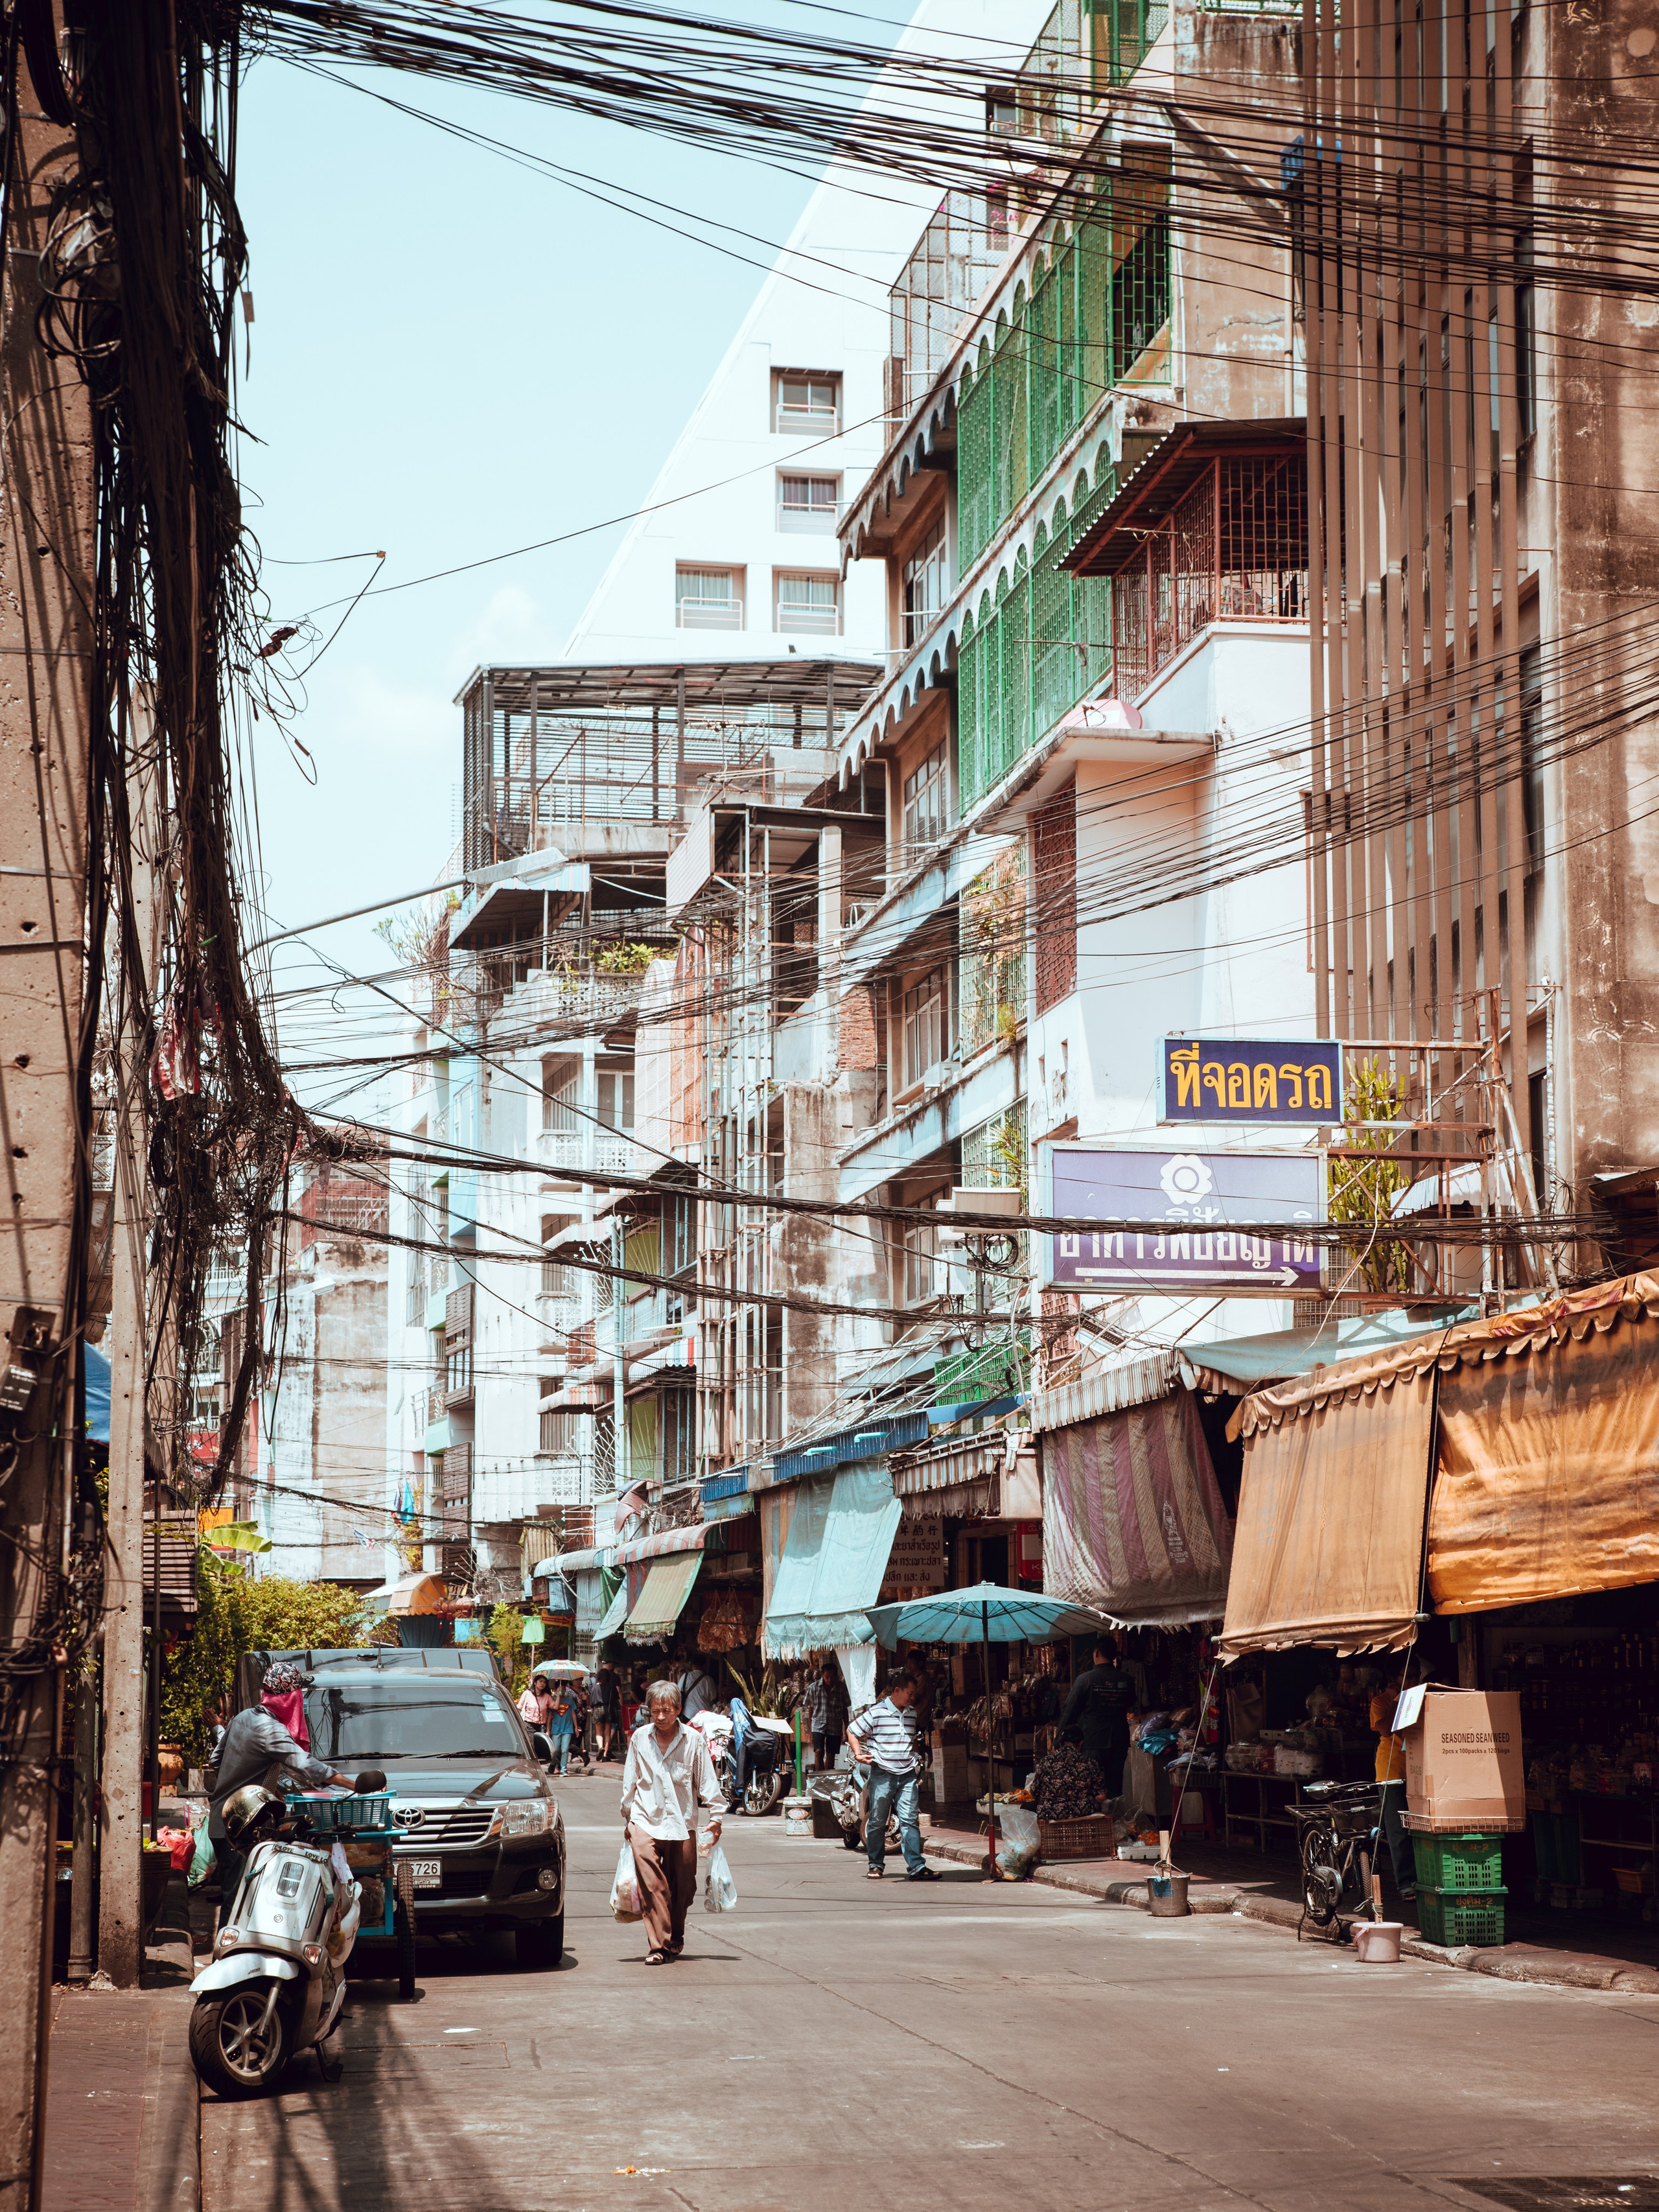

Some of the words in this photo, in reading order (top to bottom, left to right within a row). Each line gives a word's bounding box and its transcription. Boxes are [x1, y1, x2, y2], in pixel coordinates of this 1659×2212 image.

[1170, 1042, 1332, 1109] ที่จอดรถ
[883, 1570, 901, 1582] ปลีก
[904, 1572, 918, 1582] และ
[1441, 1733, 1475, 1743] SEASONED
[1476, 1732, 1510, 1743] SEANWEED
[305, 1851, 319, 1861] LOVE
